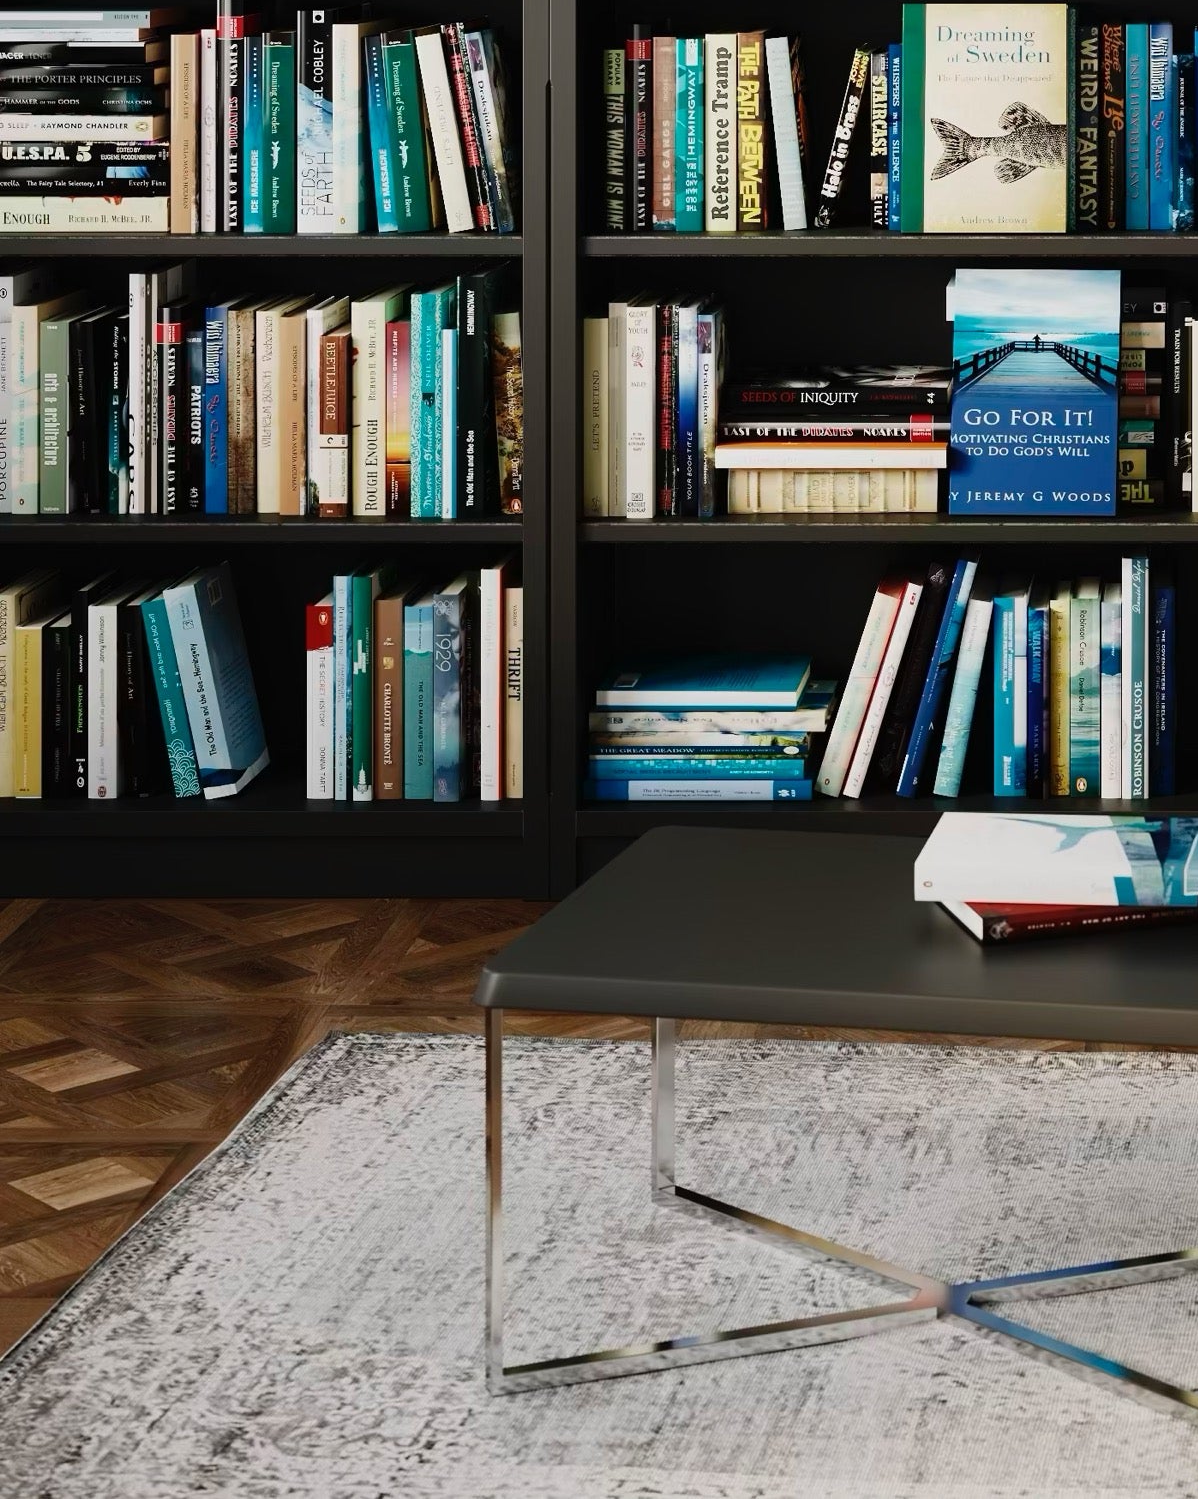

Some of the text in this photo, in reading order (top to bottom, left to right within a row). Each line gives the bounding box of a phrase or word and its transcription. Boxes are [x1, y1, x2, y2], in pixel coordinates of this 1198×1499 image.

[937, 25, 1052, 63] Dreaming of Sweden
[1103, 24, 1113, 93] Shadows
[1112, 25, 1125, 72] Where
[11, 75, 142, 84] THE PORTER PRINCIPLES
[313, 40, 324, 135] MICHAEL COBLEY
[687, 69, 696, 155] HEMINGWAY
[711, 47, 732, 220] Reference Tramp
[737, 42, 762, 223] THE PATH BETWEEN
[893, 112, 897, 120] IN
[1079, 38, 1098, 226] WEIRD FANTASY
[1104, 93, 1124, 131] Lie
[607, 94, 624, 230] THIS WOMAN IS MINE
[821, 95, 860, 198] Halo in Brass
[129, 180, 149, 188] Everly
[960, 216, 1028, 224] Andrew Brown
[467, 290, 475, 335] HEMMINGWAY
[191, 385, 201, 445] PATRIOTS
[742, 392, 858, 405] SEEDS OF INIQUITY
[365, 419, 378, 512] ROUGH ENOUGH
[435, 634, 451, 672] 1929
[508, 647, 521, 701] THRIFT
[1032, 630, 1041, 683] WALKAWAY
[1133, 681, 1142, 797] ROBINSON CRUSOE
